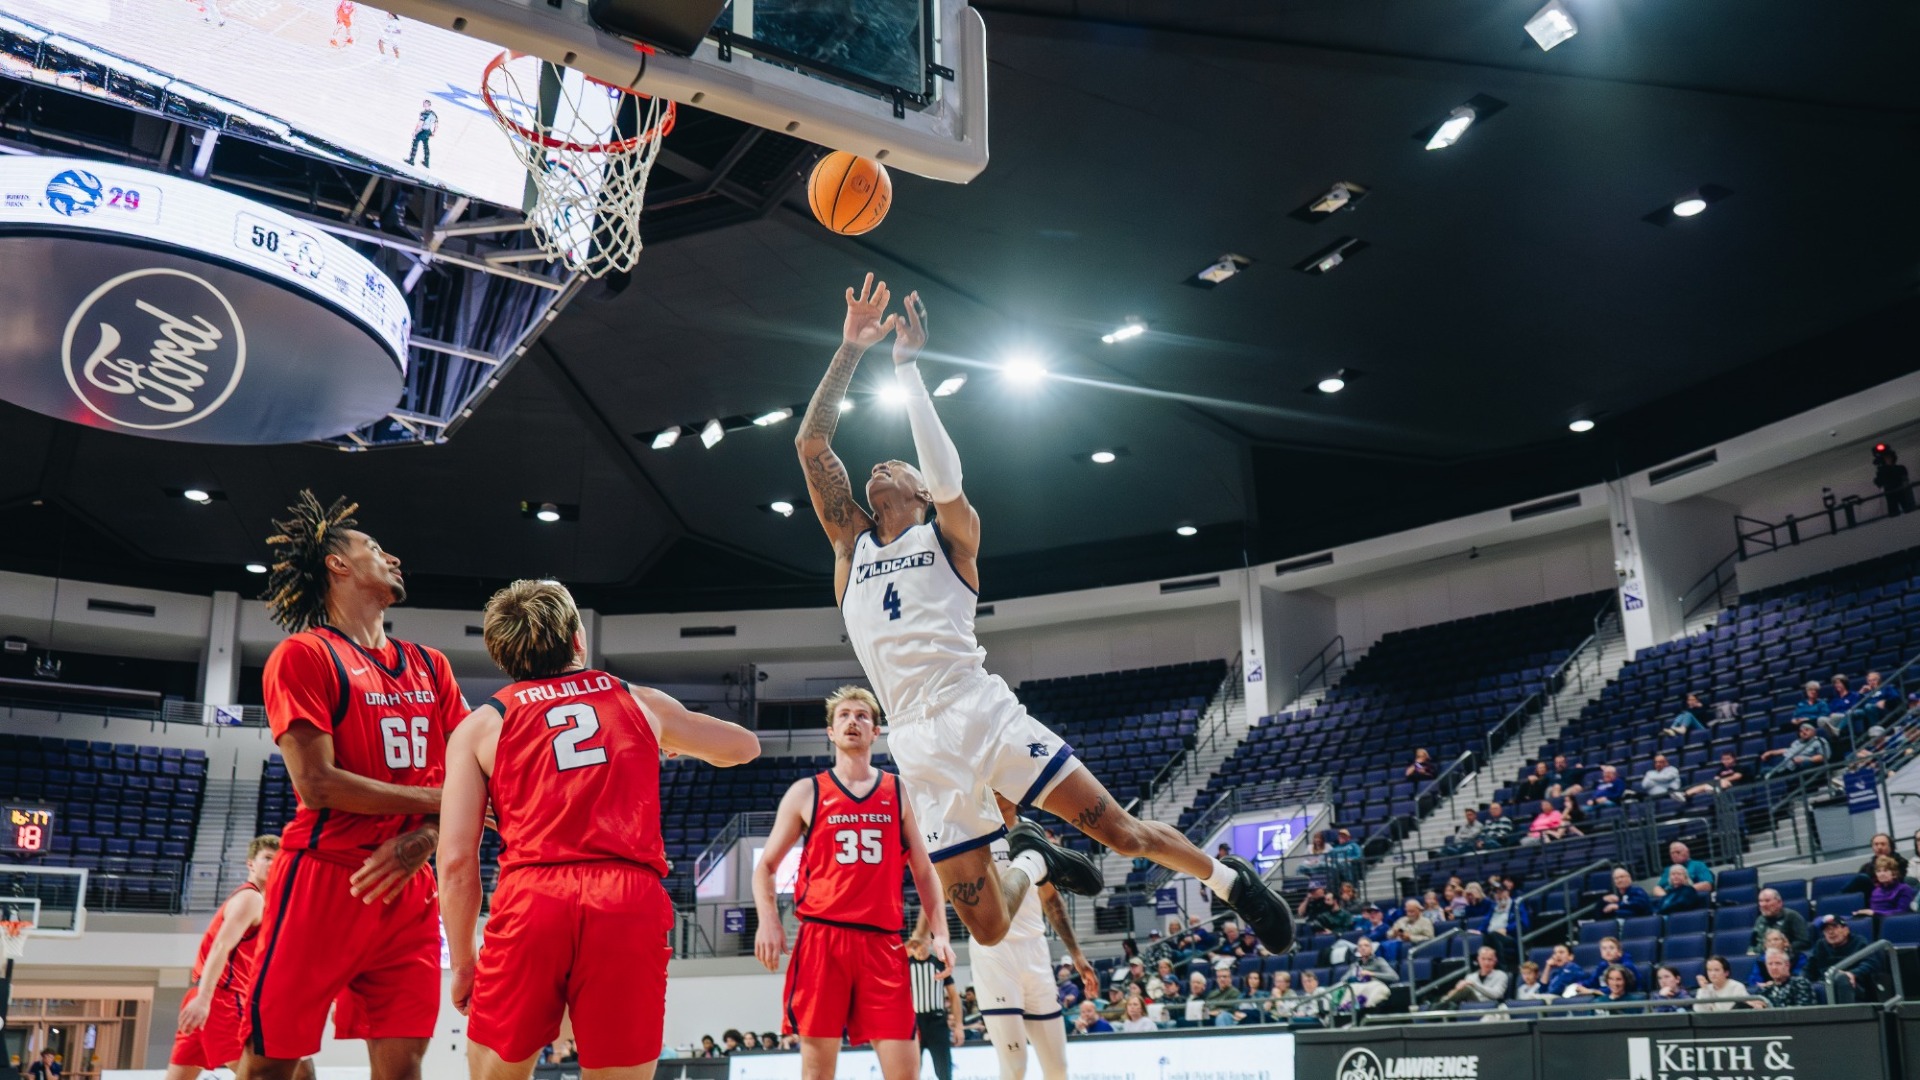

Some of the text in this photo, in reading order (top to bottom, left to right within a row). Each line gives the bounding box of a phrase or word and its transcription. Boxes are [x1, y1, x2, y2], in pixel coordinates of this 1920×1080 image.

[107, 187, 140, 210] 29
[252, 225, 279, 252] 50
[84, 299, 223, 412] Ford
[856, 551, 934, 584] WILDCATS
[882, 582, 901, 621] 4
[365, 690, 435, 706] UTAH TECH
[514, 676, 612, 704] TRUJILLO
[380, 715, 429, 769] 66
[545, 702, 608, 772] 2
[827, 813, 892, 824] UTAH TECH
[17, 825, 42, 850] 18
[835, 828, 883, 865] 35
[1384, 1055, 1479, 1079] LAWRENCE
[1657, 1041, 1795, 1072] KEITH &
